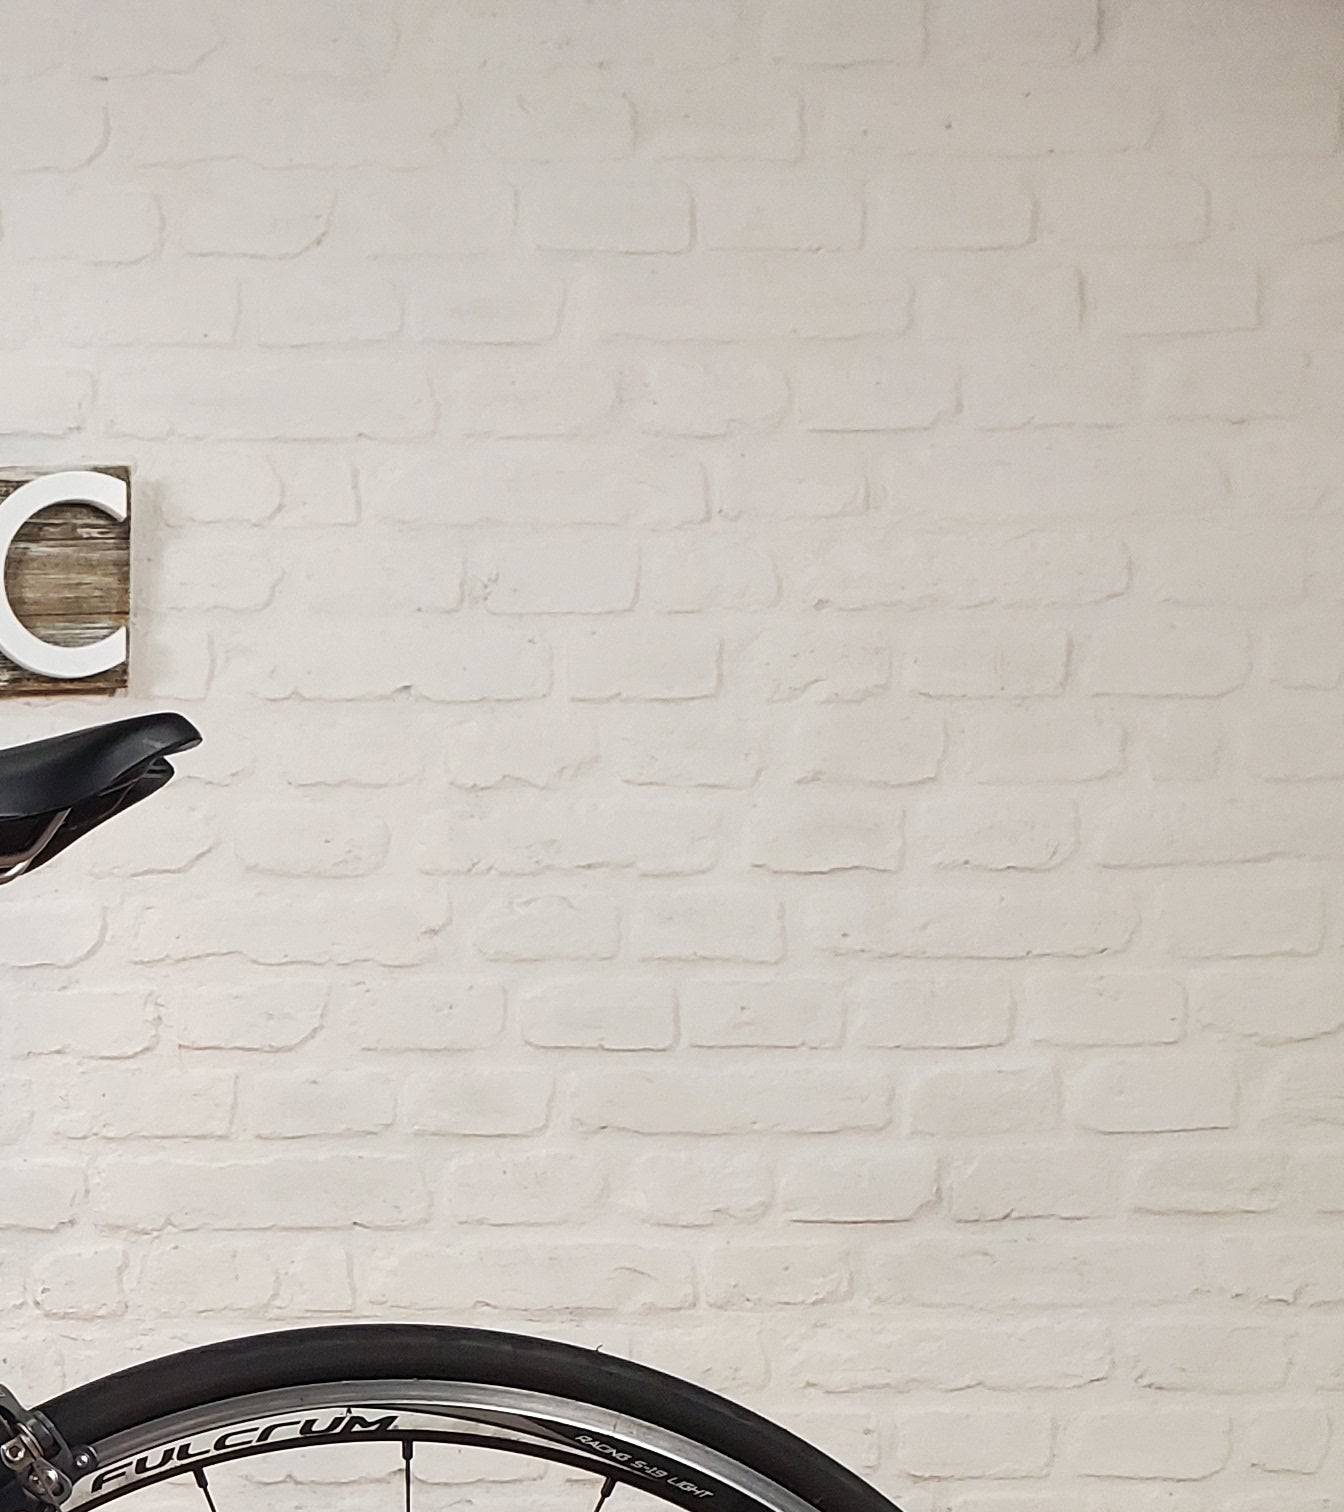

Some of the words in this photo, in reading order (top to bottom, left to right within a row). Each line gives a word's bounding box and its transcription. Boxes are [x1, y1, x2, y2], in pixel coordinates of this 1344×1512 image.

[90, 1414, 400, 1493] FULCRUM
[575, 1435, 632, 1461] RACING
[667, 1477, 713, 1498] LIGHT
